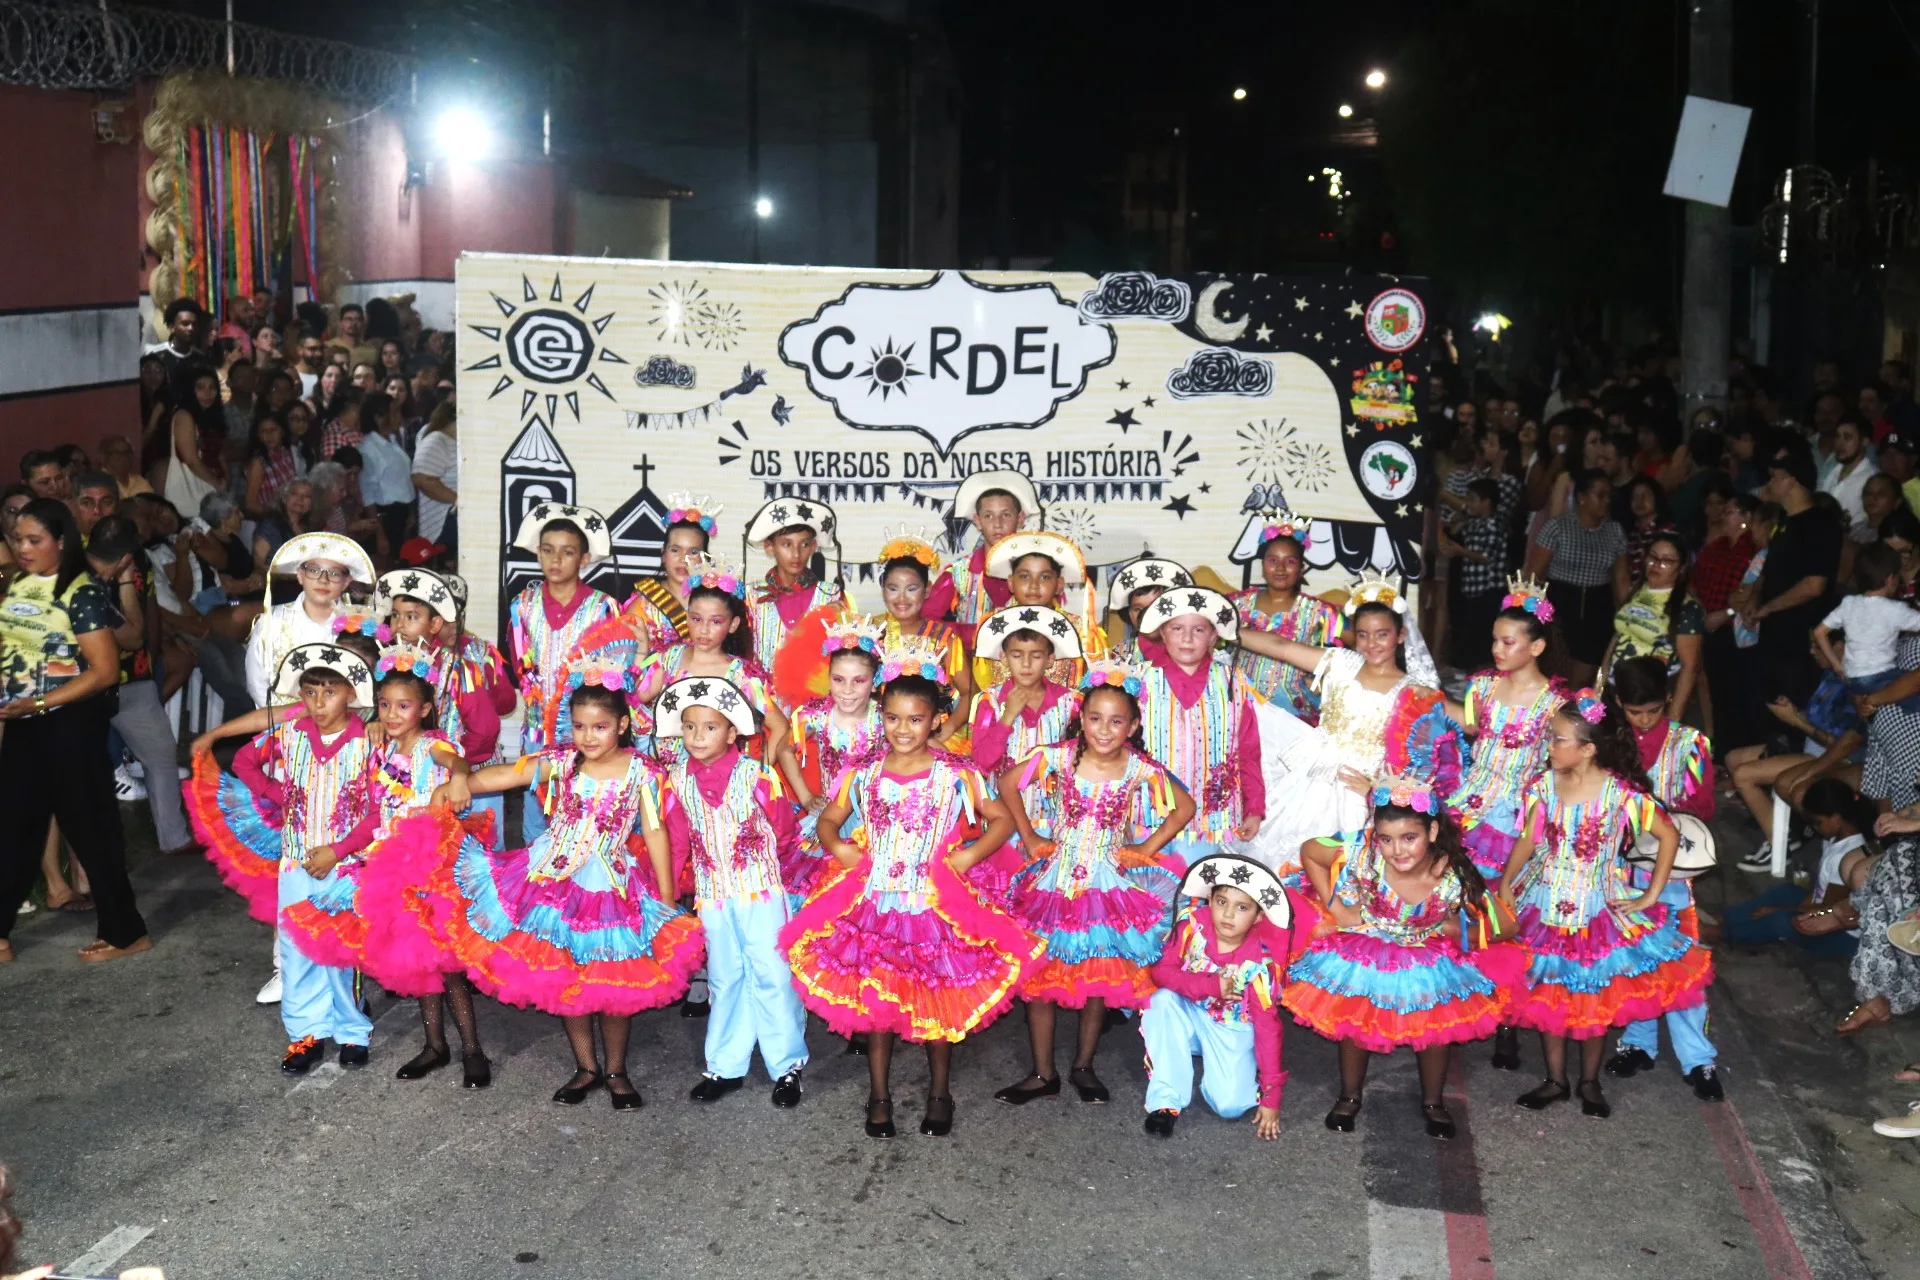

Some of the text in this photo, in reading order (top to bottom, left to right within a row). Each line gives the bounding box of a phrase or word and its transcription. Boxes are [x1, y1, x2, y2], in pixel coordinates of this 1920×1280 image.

[750, 443, 1162, 478] OS VERSOS DA NOSSA HISTÓRIA
